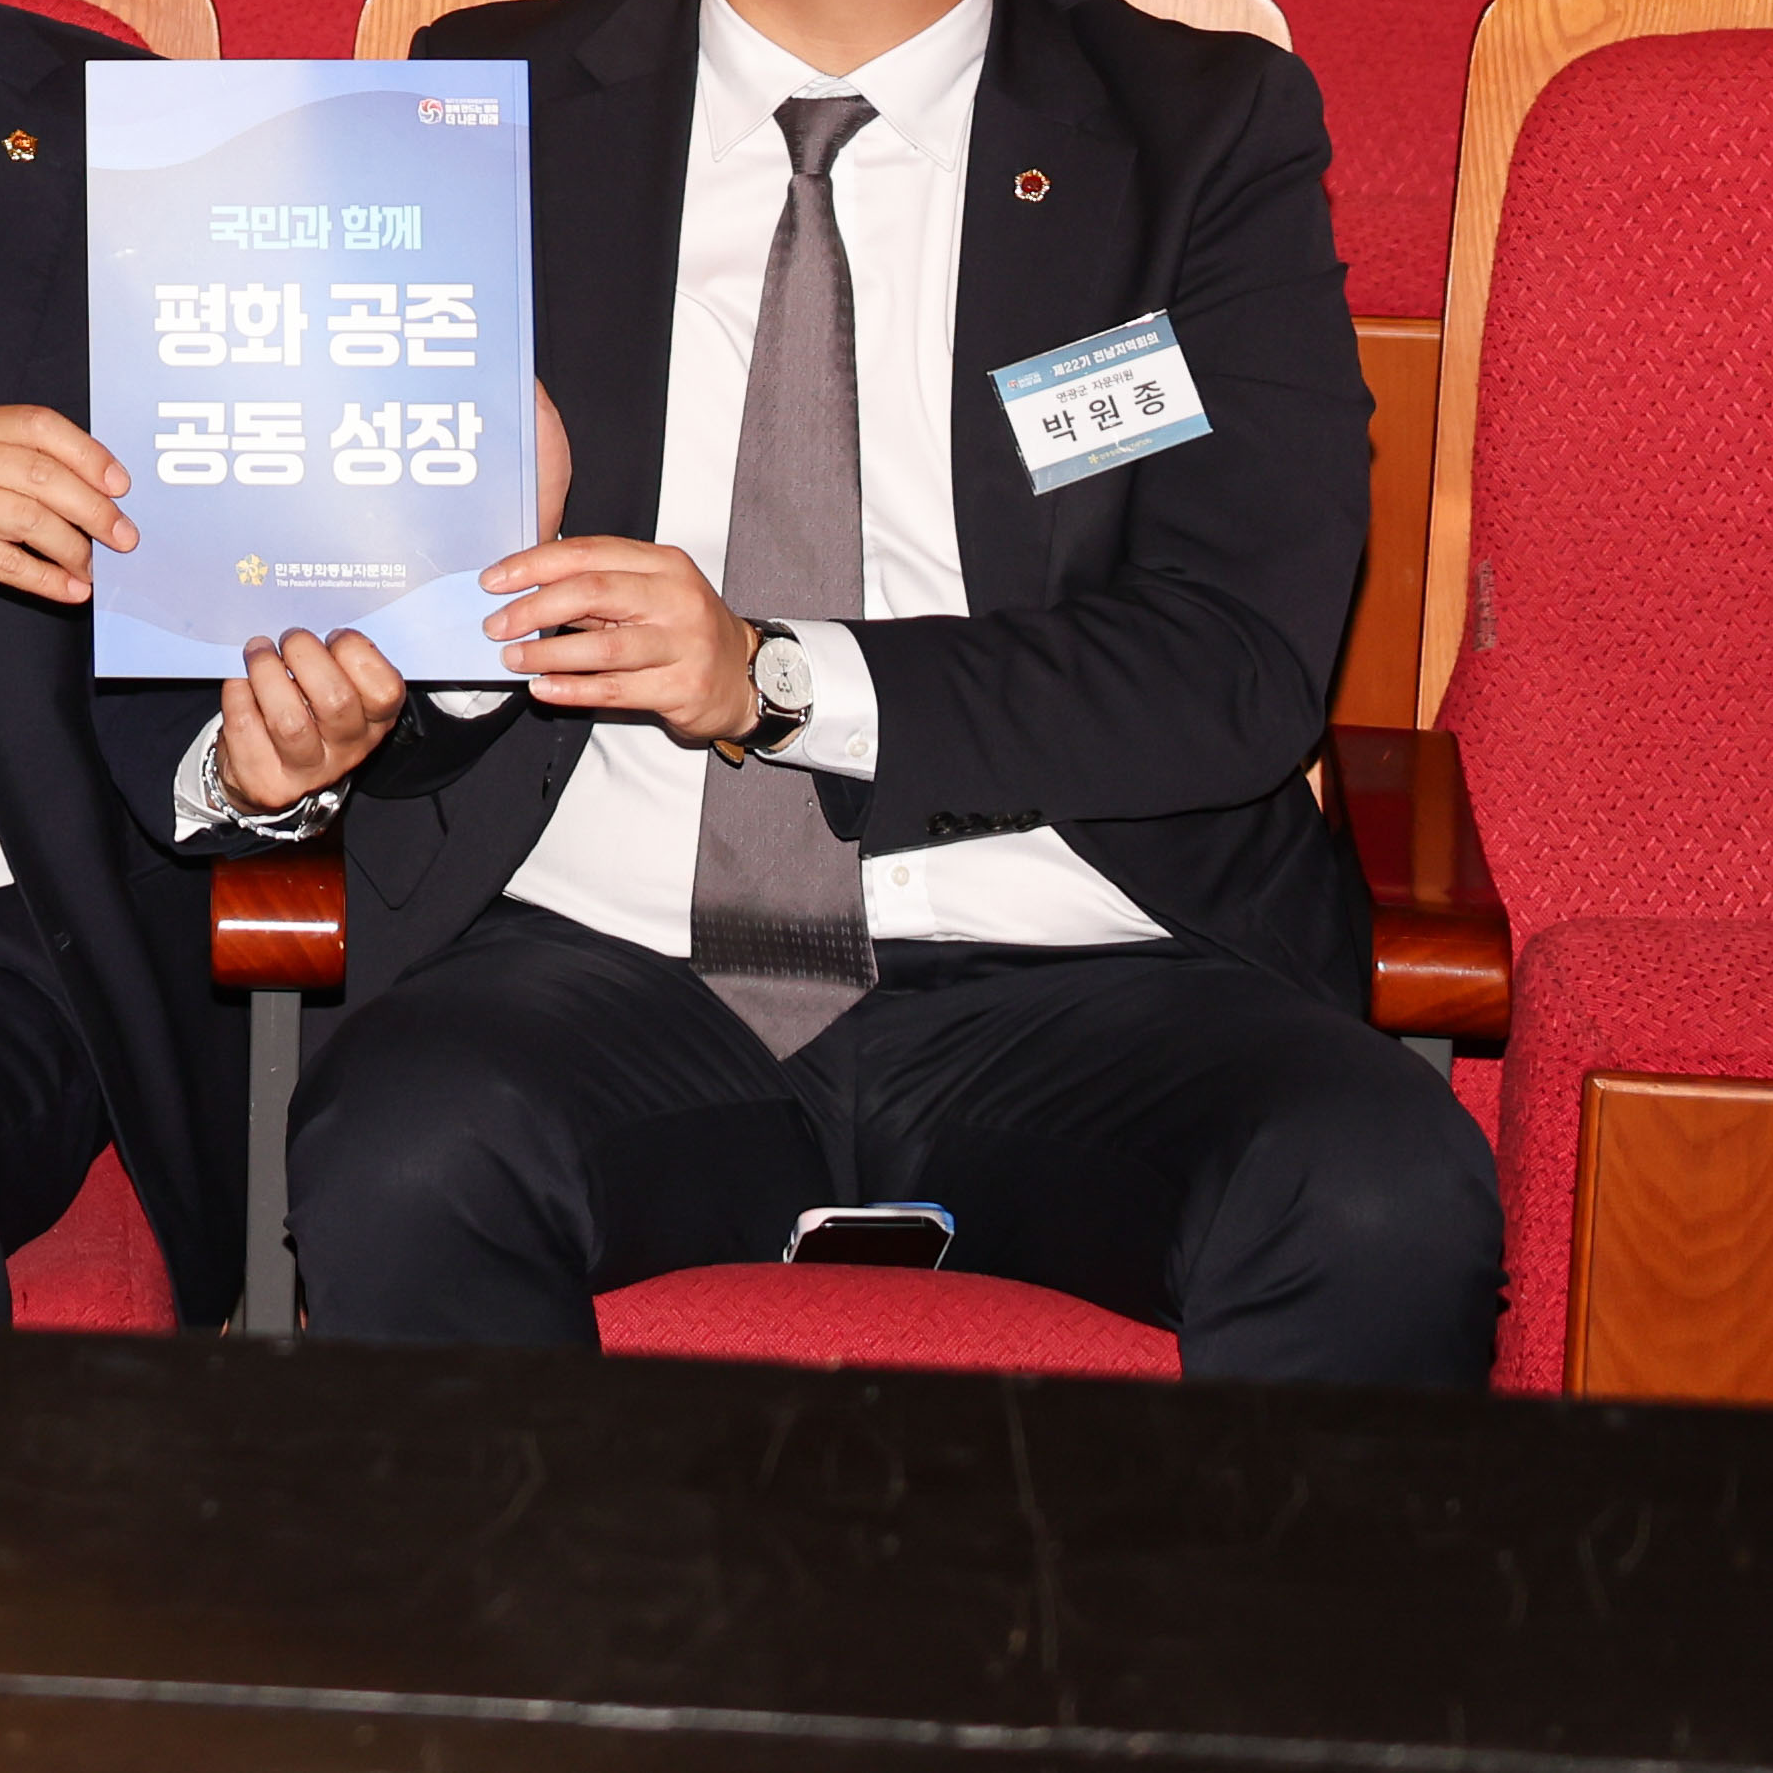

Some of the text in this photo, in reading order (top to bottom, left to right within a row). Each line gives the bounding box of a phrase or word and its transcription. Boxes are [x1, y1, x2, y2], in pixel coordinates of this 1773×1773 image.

[207, 205, 421, 252] 국민과 함께
[155, 283, 477, 369] 평화 공존
[1052, 331, 1160, 378] 제22기 전남지역회의
[155, 401, 482, 488] 공동 성장
